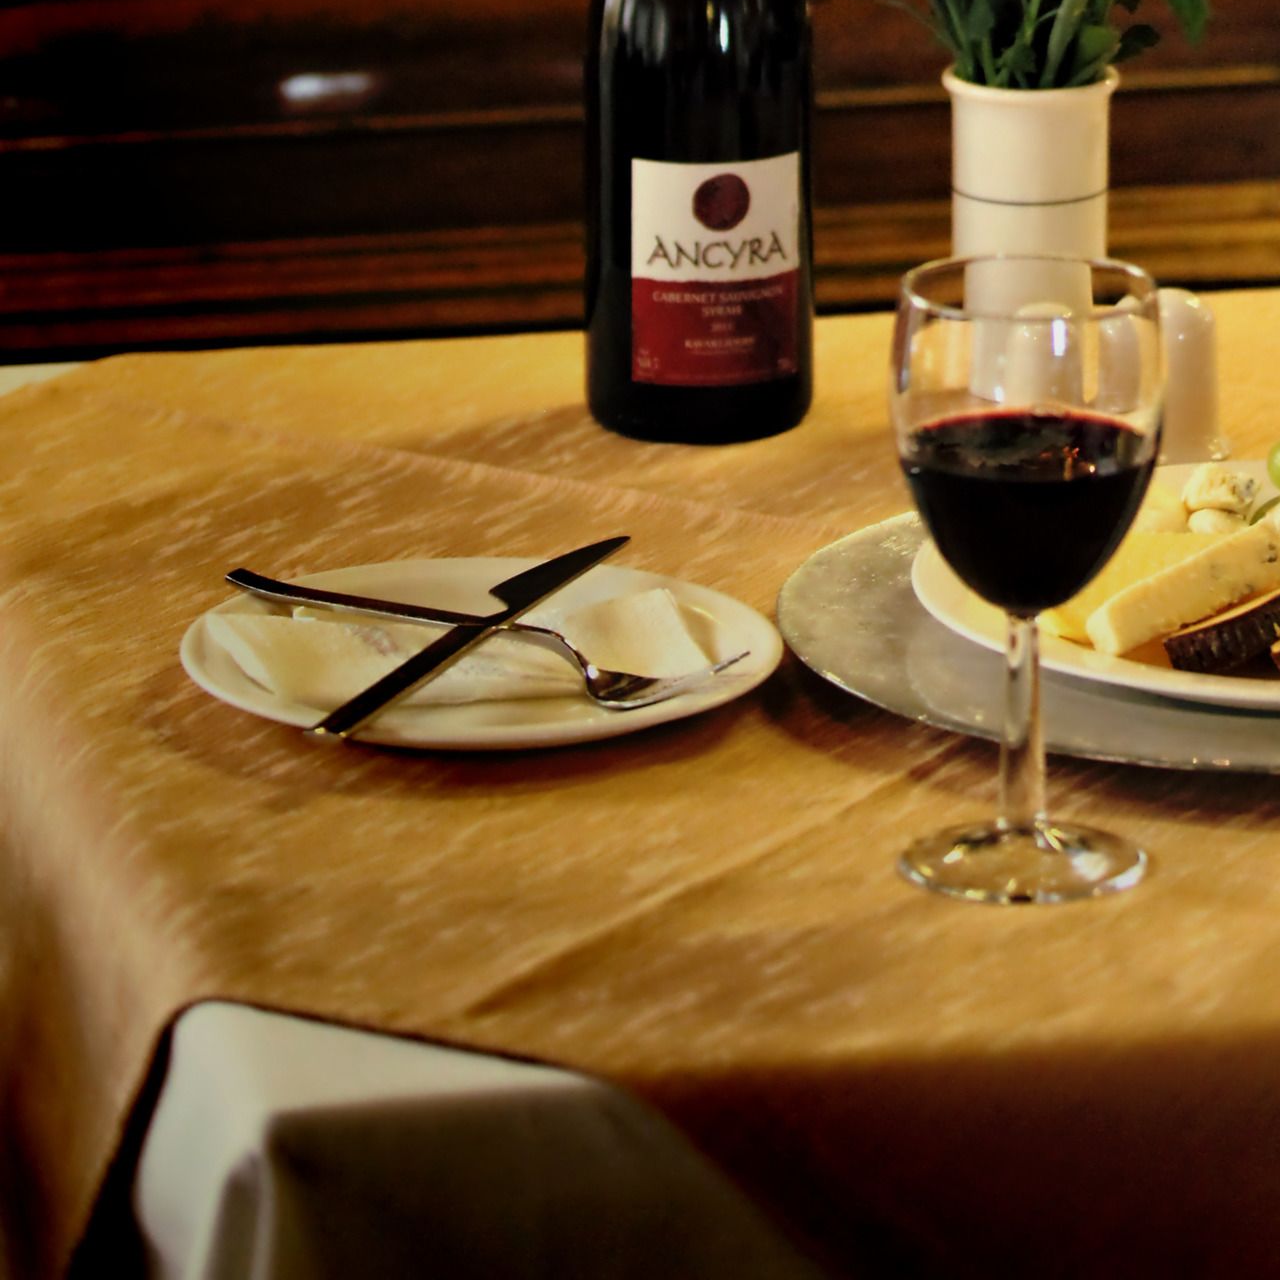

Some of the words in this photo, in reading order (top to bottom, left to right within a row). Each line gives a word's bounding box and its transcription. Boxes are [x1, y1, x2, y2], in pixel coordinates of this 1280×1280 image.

[647, 231, 787, 269] ANCYRA
[652, 290, 716, 303] CABERNET
[702, 305, 742, 317] SYRAH
